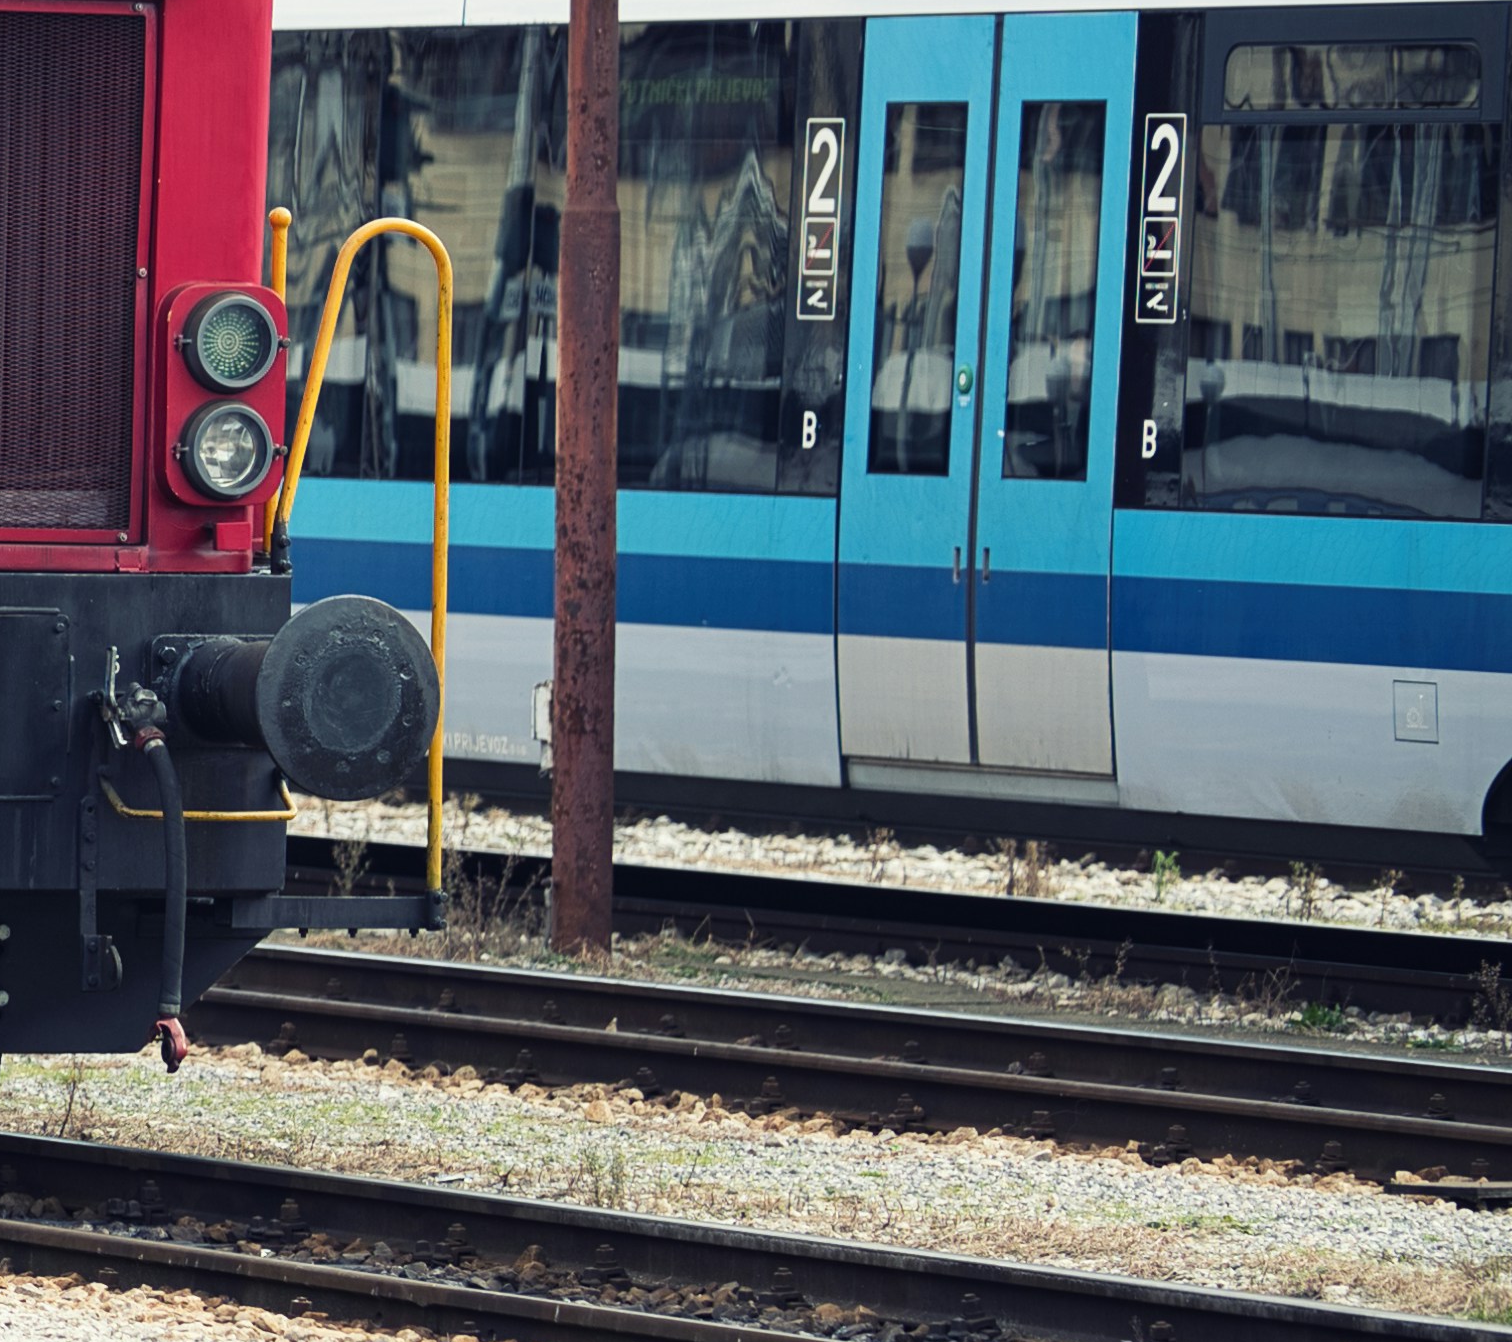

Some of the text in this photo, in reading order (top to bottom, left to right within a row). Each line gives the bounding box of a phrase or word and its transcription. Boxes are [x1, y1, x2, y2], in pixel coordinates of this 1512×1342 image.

[808, 127, 838, 213] 2
[1147, 123, 1179, 211] 2
[802, 411, 817, 449] B
[1142, 419, 1158, 458] B
